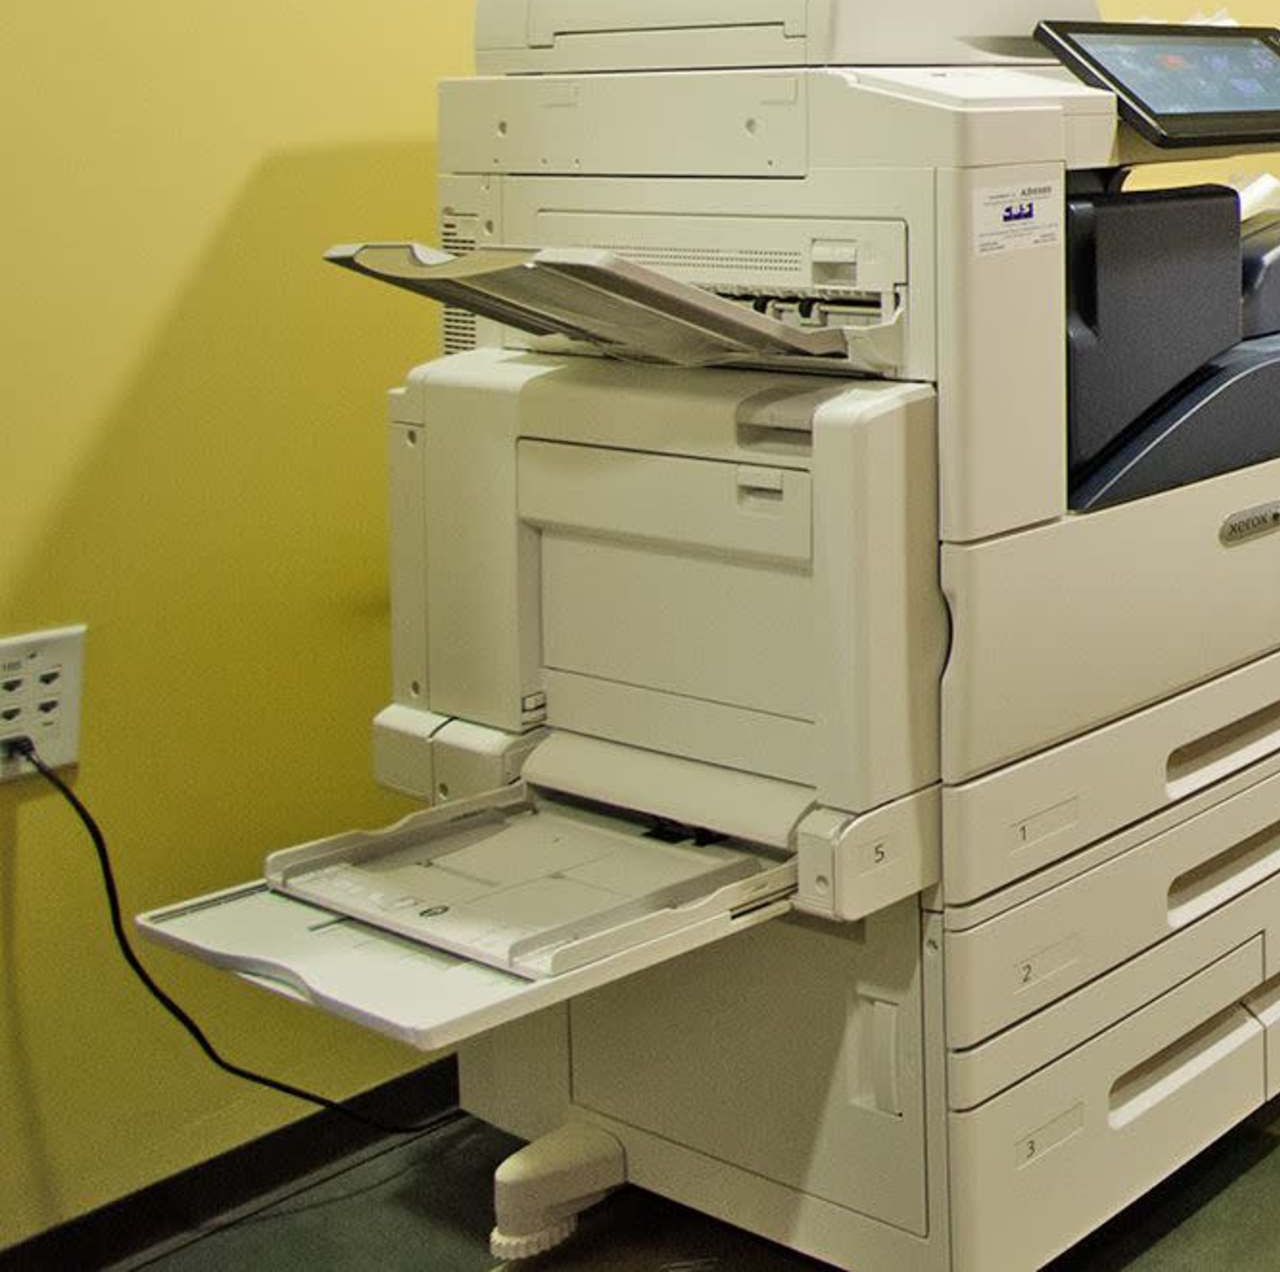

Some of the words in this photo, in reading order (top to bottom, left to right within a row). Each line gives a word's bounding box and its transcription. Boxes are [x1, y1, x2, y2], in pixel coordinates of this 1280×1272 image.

[1018, 825, 1027, 841] 1
[874, 843, 885, 864] 5
[1021, 963, 1032, 983] 2
[1026, 1139, 1036, 1158] 3
